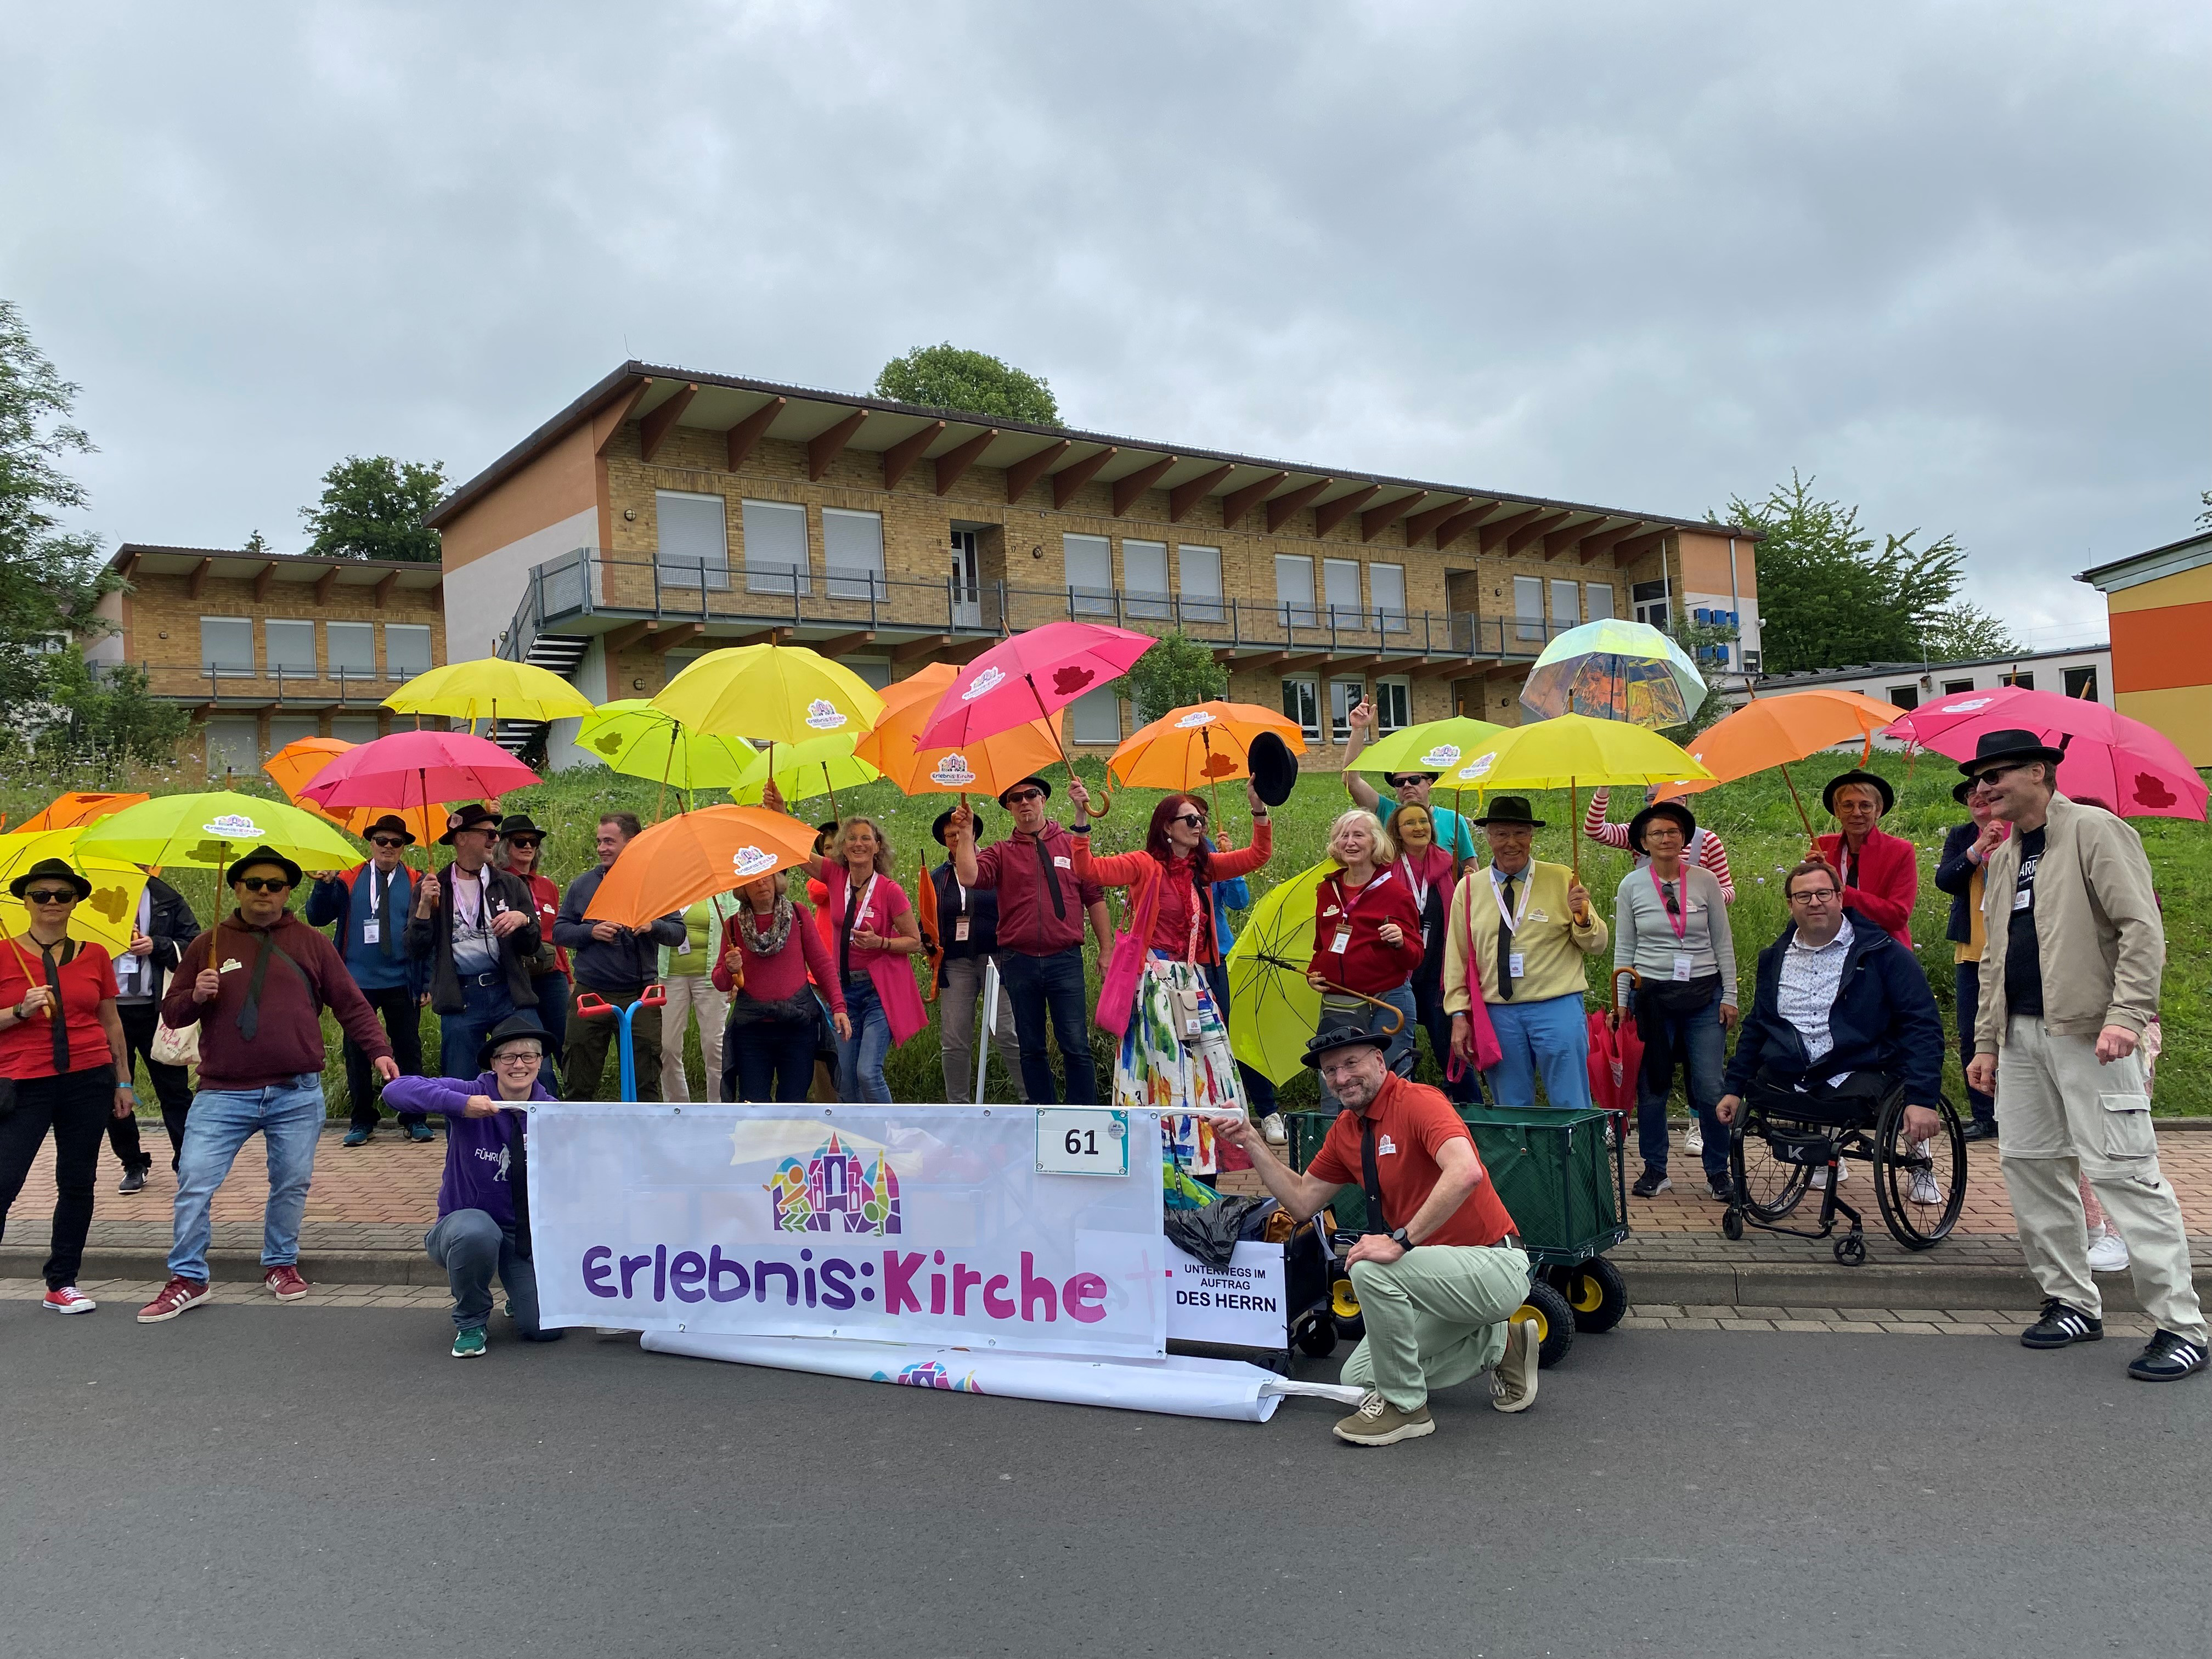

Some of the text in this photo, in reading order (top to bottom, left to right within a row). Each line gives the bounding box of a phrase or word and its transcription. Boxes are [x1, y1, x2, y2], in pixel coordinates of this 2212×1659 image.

[1065, 1128, 1099, 1155] 61
[1787, 1144, 1804, 1160] K
[582, 1244, 1107, 1323] Erlebnis:Kirche
[1254, 1269, 1266, 1279] IM
[1200, 1278, 1251, 1290] AUFTRAG
[1176, 1290, 1277, 1313] DES HERRN
